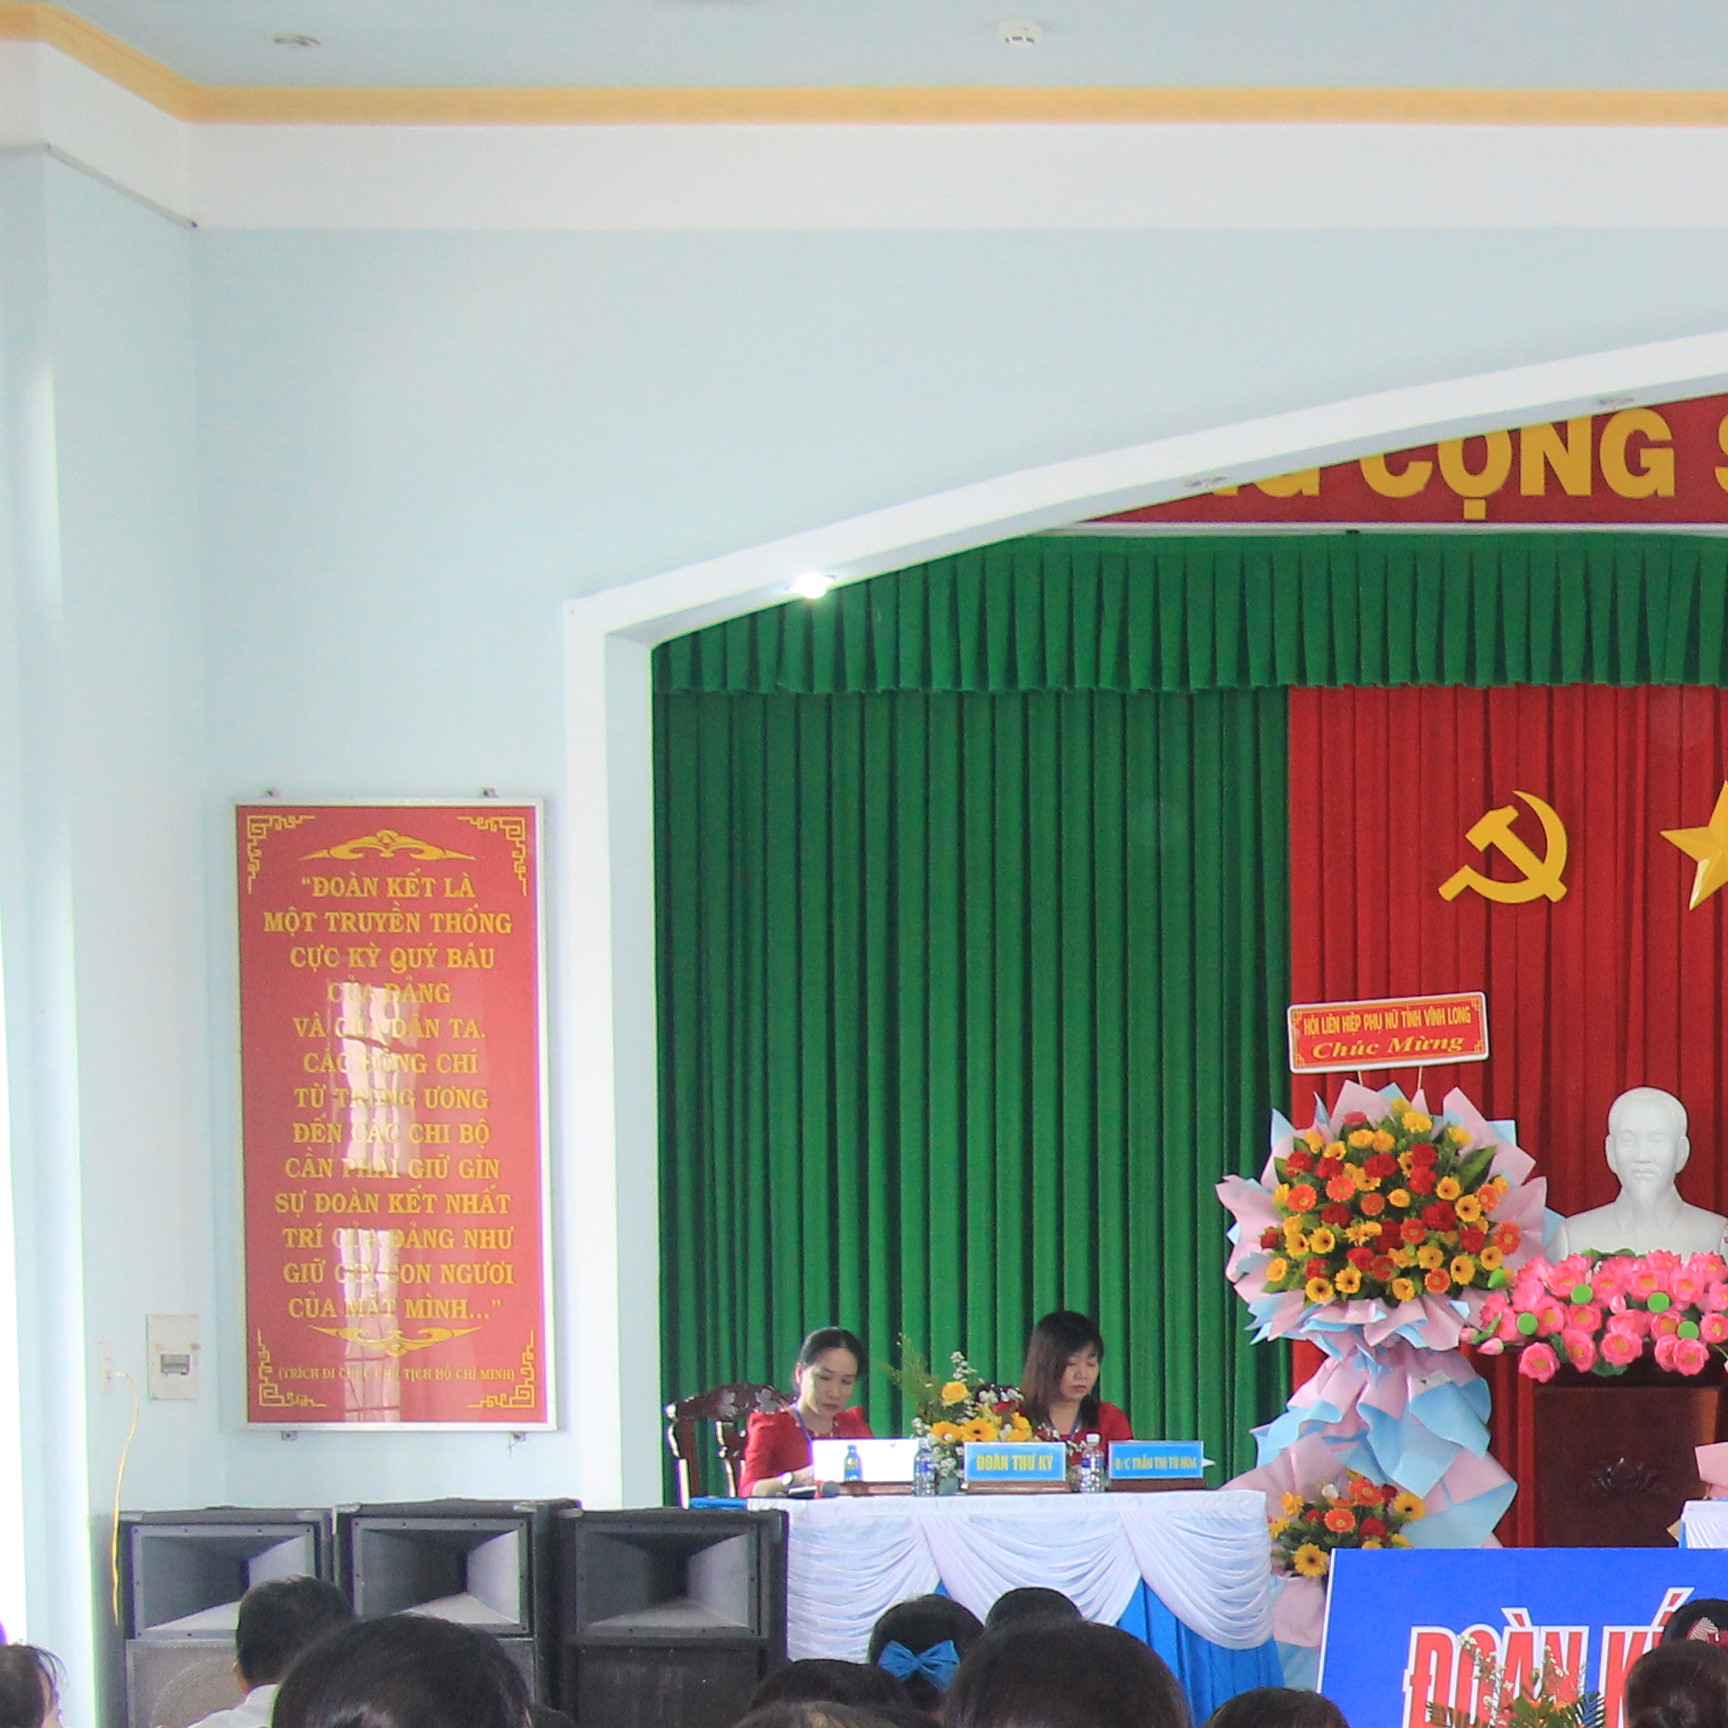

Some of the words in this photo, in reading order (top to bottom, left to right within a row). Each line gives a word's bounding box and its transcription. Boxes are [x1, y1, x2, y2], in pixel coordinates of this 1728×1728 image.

[387, 868, 436, 897] KẾT
[444, 872, 475, 898] LÀ
[263, 906, 317, 936] MỘT
[325, 901, 421, 932] TRUYỀN
[430, 904, 512, 933] THỐNG
[290, 944, 340, 972] CỰC
[348, 942, 381, 968] KỲ
[389, 942, 438, 973] QUÝ
[447, 942, 495, 968] BÁU
[293, 1012, 327, 1038] VÀ
[435, 1048, 479, 1074] CHÍ
[1312, 1038, 1380, 1060] Chúc
[1387, 1035, 1465, 1054] Mừng
[294, 1082, 327, 1109] TỪ
[424, 1085, 490, 1109] ƯƠNG
[293, 1112, 342, 1144] ĐẾN
[408, 1123, 452, 1145] CHI
[458, 1118, 491, 1150] BỘ
[284, 1146, 334, 1178] CẦN
[407, 1153, 451, 1179] GIỮ
[458, 1152, 501, 1179] GÌN
[275, 1189, 307, 1218] SỰ
[314, 1188, 381, 1214] ĐOÀN
[388, 1183, 437, 1214] KẾT
[445, 1183, 512, 1214] NHẤT
[282, 1222, 323, 1248] TRÍ
[463, 1225, 515, 1249] NHƯ
[283, 1258, 327, 1283] GIỮ
[288, 1290, 337, 1319] CỦA
